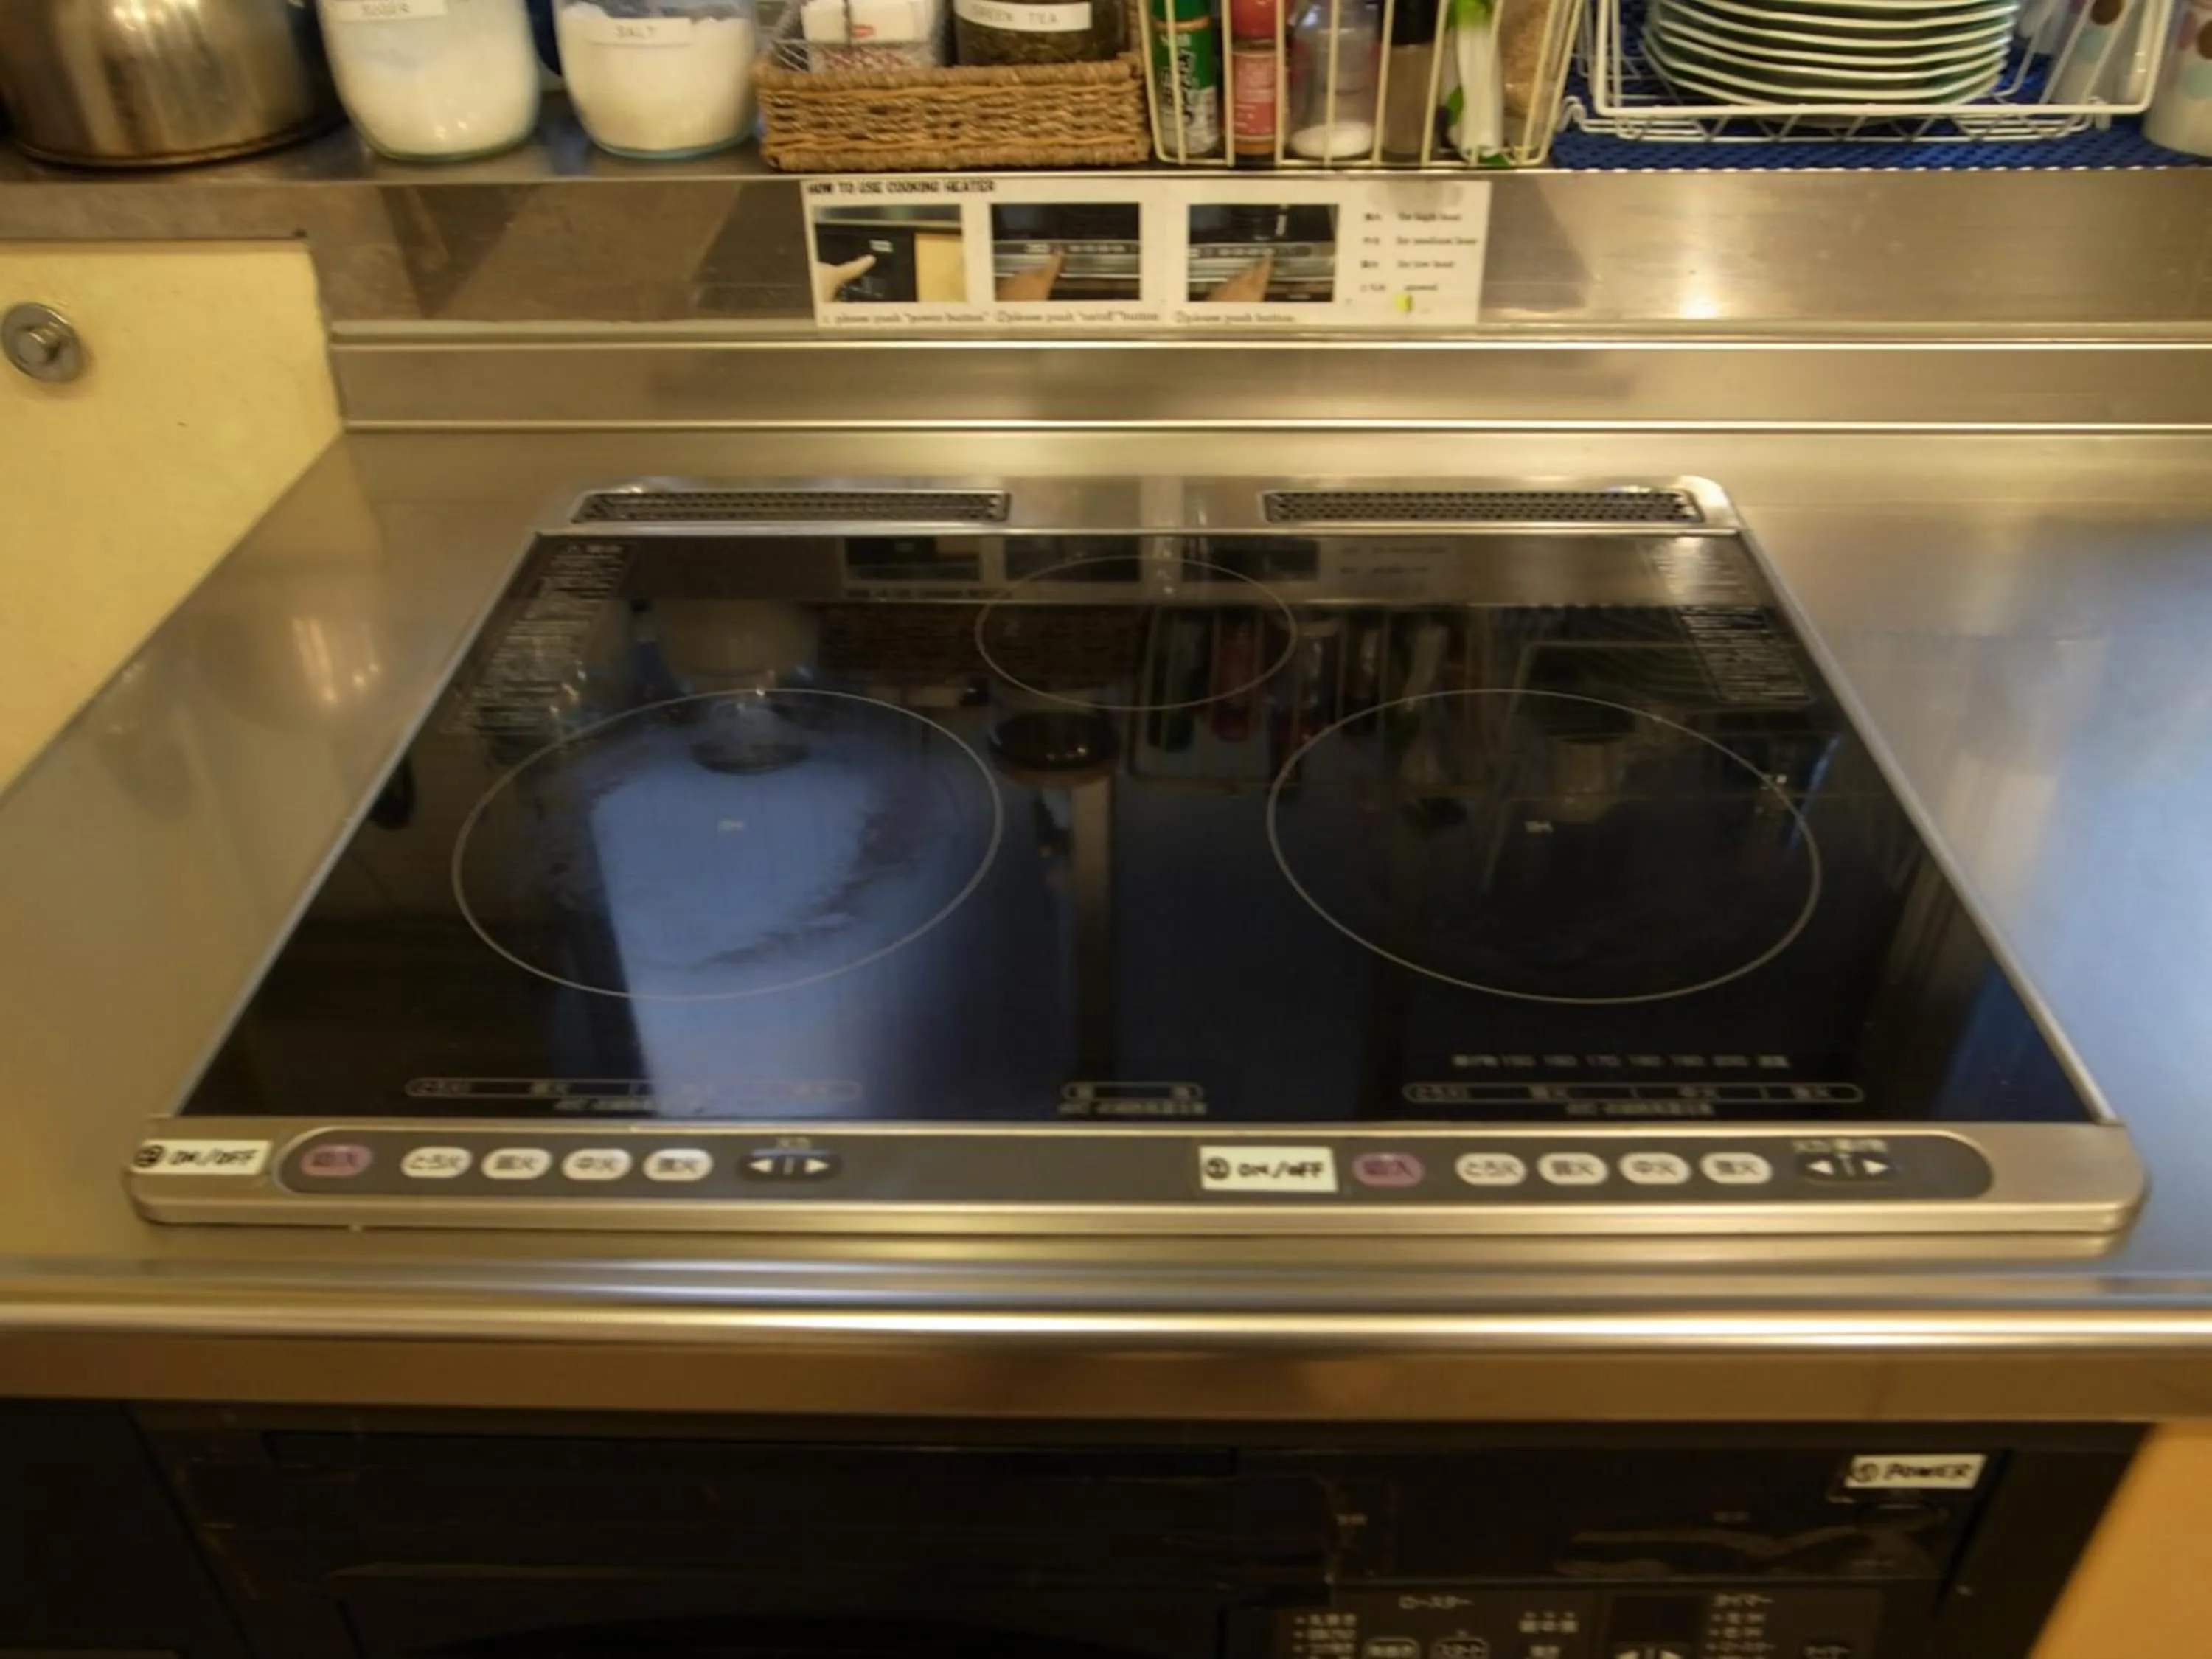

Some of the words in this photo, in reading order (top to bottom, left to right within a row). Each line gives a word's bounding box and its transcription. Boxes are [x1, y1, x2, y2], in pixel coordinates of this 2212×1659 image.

[1027, 10, 1059, 25] TEA
[614, 24, 656, 39] SALT
[808, 181, 832, 194] HOW
[838, 181, 854, 193] TO
[859, 181, 883, 193] USE
[886, 181, 939, 193] COOKING
[945, 179, 995, 193] HEATER
[1237, 1160, 1325, 1178] ON/OFF
[1884, 1462, 1972, 1480] POWER
